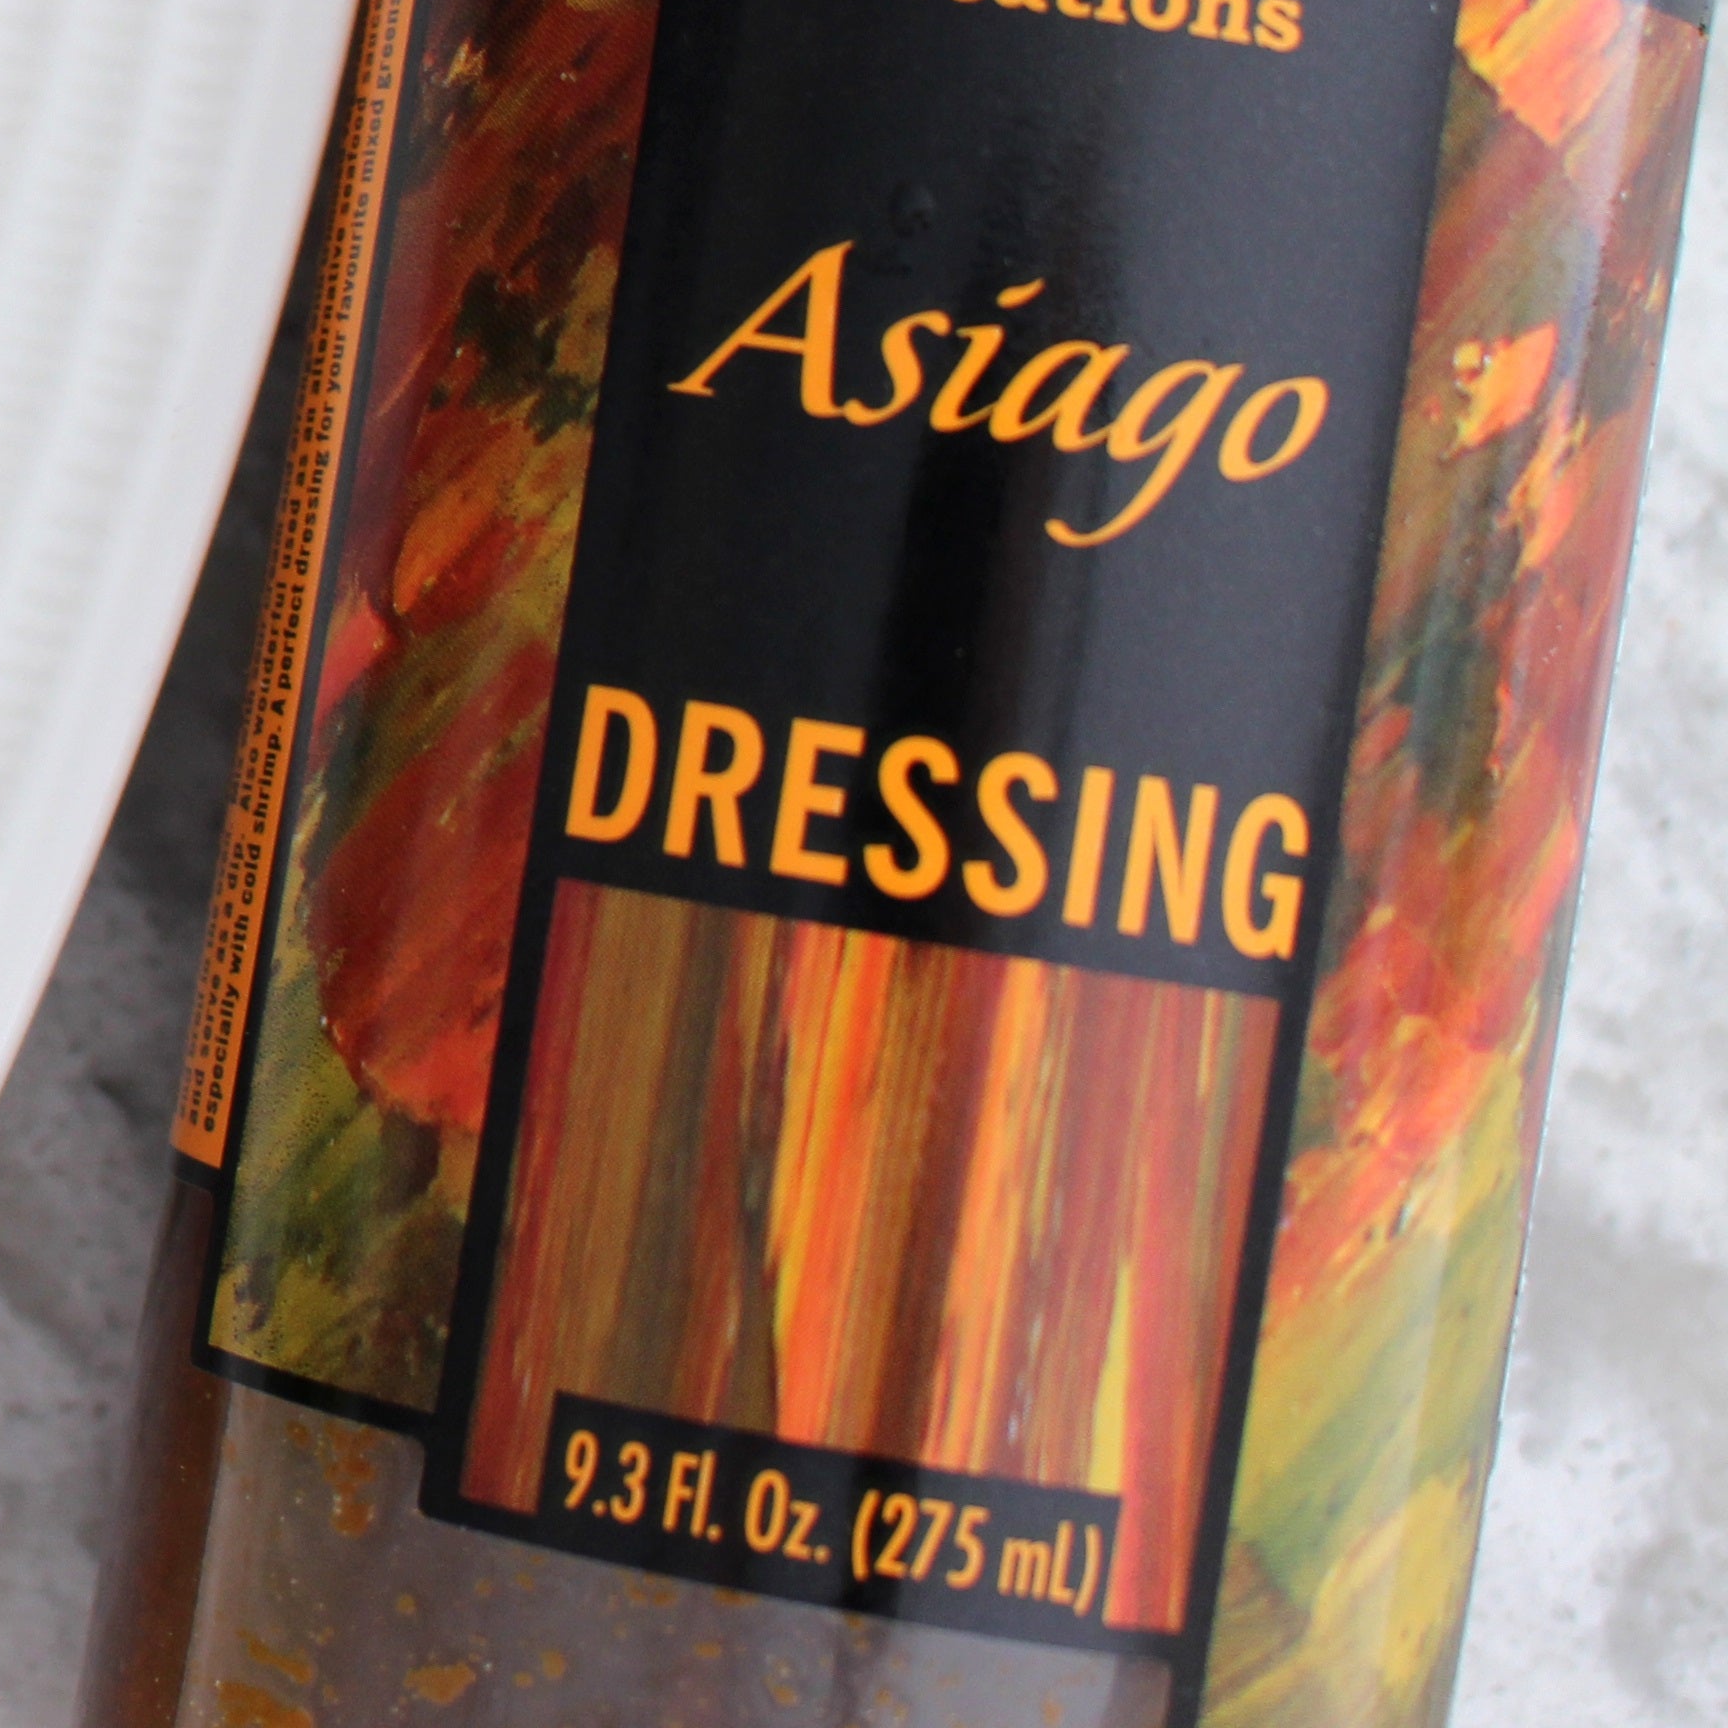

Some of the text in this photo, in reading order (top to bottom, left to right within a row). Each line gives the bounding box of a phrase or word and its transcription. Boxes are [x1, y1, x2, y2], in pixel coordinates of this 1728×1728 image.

[339, 95, 367, 215] seafood
[361, 99, 385, 183] mixed
[335, 193, 369, 322] favourite
[310, 227, 346, 395] alternative
[326, 331, 347, 394] your
[303, 408, 317, 442] an
[314, 402, 335, 442] for
[295, 454, 309, 487] as
[281, 499, 301, 570] used
[293, 451, 330, 577] dressing
[253, 581, 287, 736] wonderful
[277, 584, 305, 691] perfect
[270, 699, 286, 716] A
[238, 748, 259, 812] Also
[252, 725, 284, 835] shrimp.
[567, 686, 1311, 961] DRESSING
[226, 833, 247, 891] dip.
[241, 843, 262, 906] cold
[224, 902, 234, 919] a
[229, 914, 250, 975] with
[216, 930, 229, 963] as
[200, 974, 222, 1058] serve
[203, 983, 240, 1133] especially
[189, 1068, 205, 1126] and
[567, 1432, 1103, 1614] 9.3 Fl. Oz. (275 mL)
